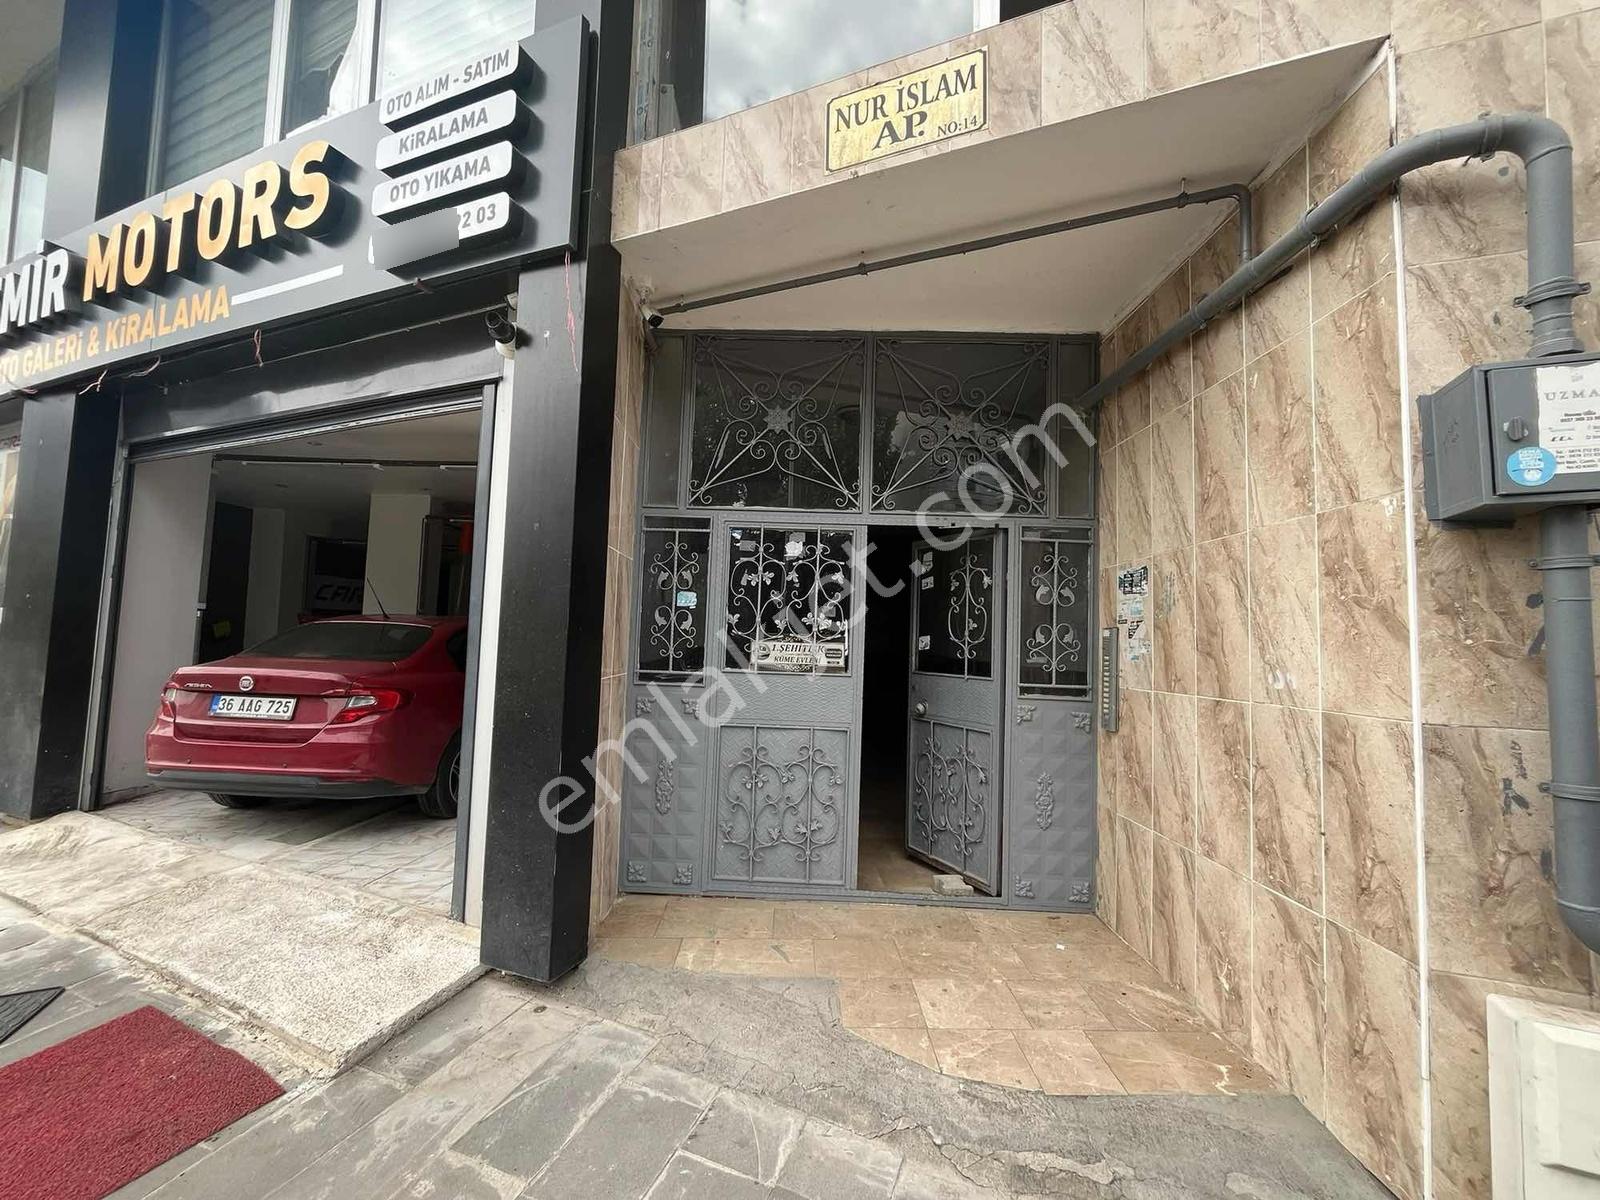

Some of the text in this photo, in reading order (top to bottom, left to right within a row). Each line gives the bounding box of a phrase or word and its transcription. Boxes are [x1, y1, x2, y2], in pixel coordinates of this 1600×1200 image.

[386, 91, 412, 116] OTO
[415, 73, 450, 104] ALIM
[463, 49, 510, 84] SATIM
[834, 63, 977, 134] NUR İSLAM
[872, 110, 978, 151] AP. NO:14
[390, 155, 491, 203] OTO YIKAMA
[476, 203, 497, 224] 03
[0, 139, 331, 334] MİR MOTORS
[87, 326, 99, 356] &
[218, 697, 235, 712] 36
[238, 699, 262, 713] AAG
[266, 700, 292, 714] 725
